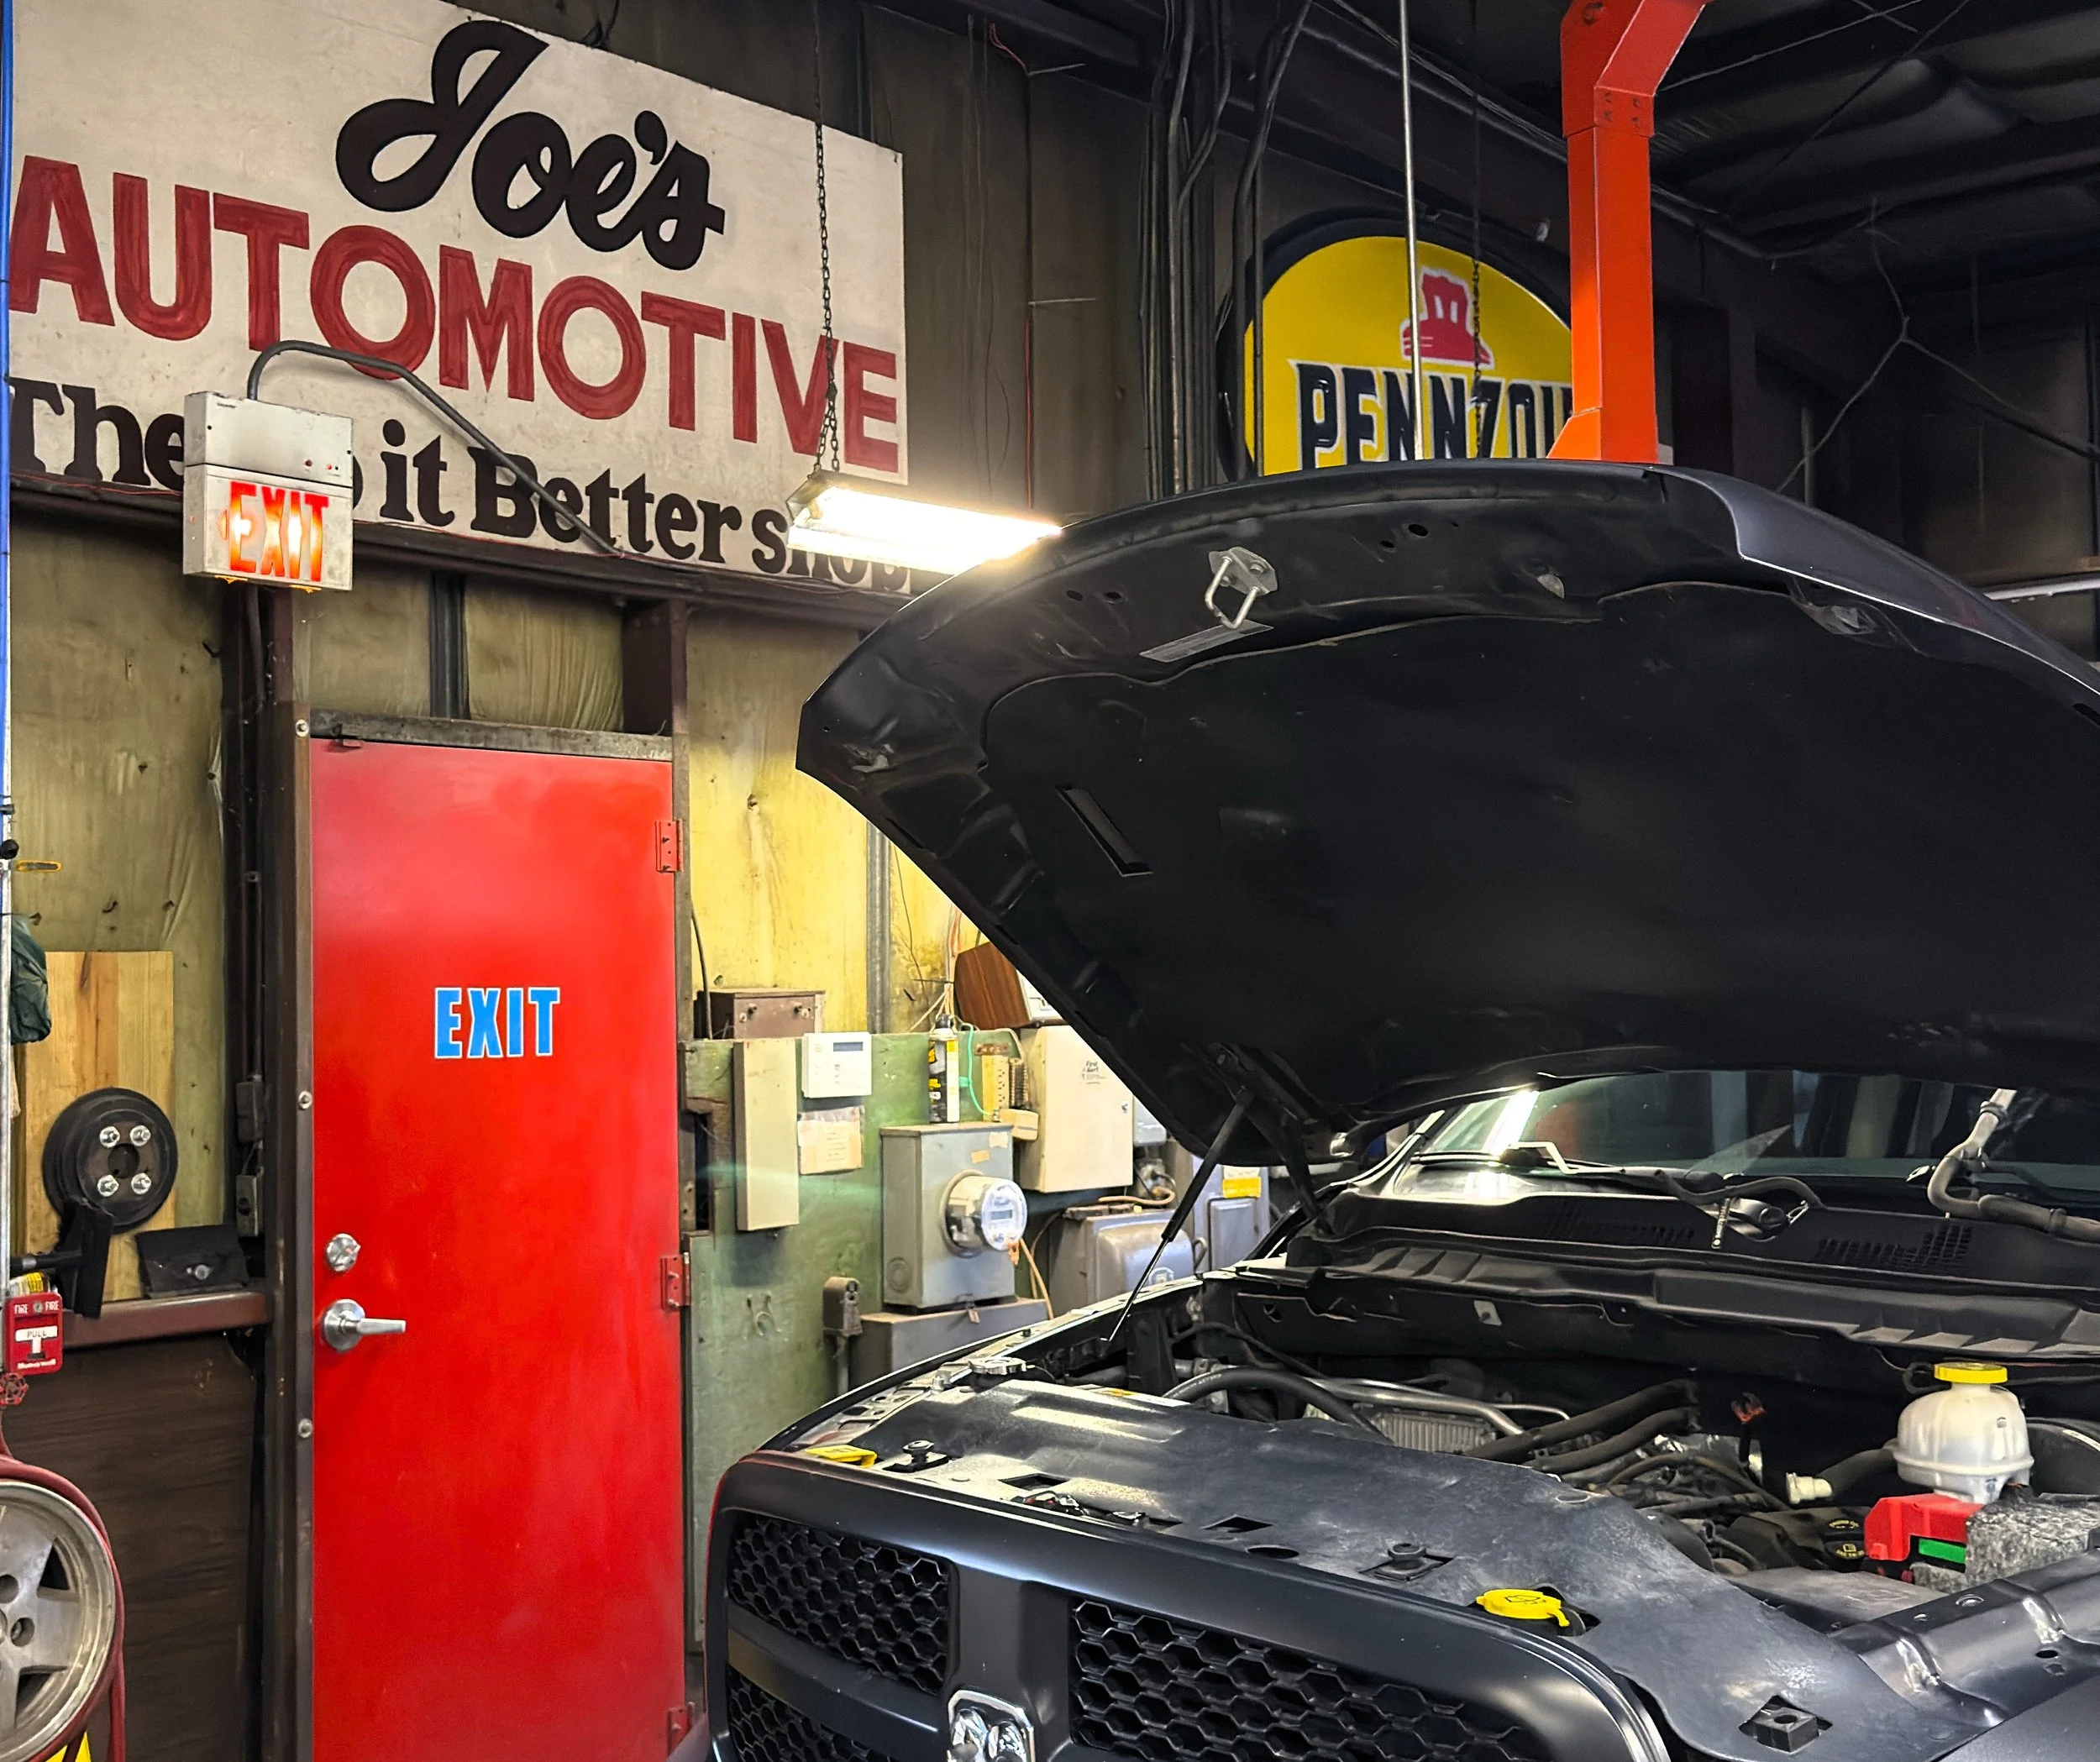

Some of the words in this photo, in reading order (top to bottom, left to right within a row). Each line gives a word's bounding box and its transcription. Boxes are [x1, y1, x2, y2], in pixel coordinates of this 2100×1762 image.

[336, 20, 725, 270] Joe's
[8, 155, 899, 474] AUTOMOTIVE
[7, 376, 184, 492] The
[380, 418, 456, 527] it
[468, 446, 743, 564] Better
[229, 480, 329, 582] EXIT
[434, 987, 561, 1059] EXIT
[26, 1329, 47, 1339] PULL
[45, 1300, 60, 1311] FIRE
